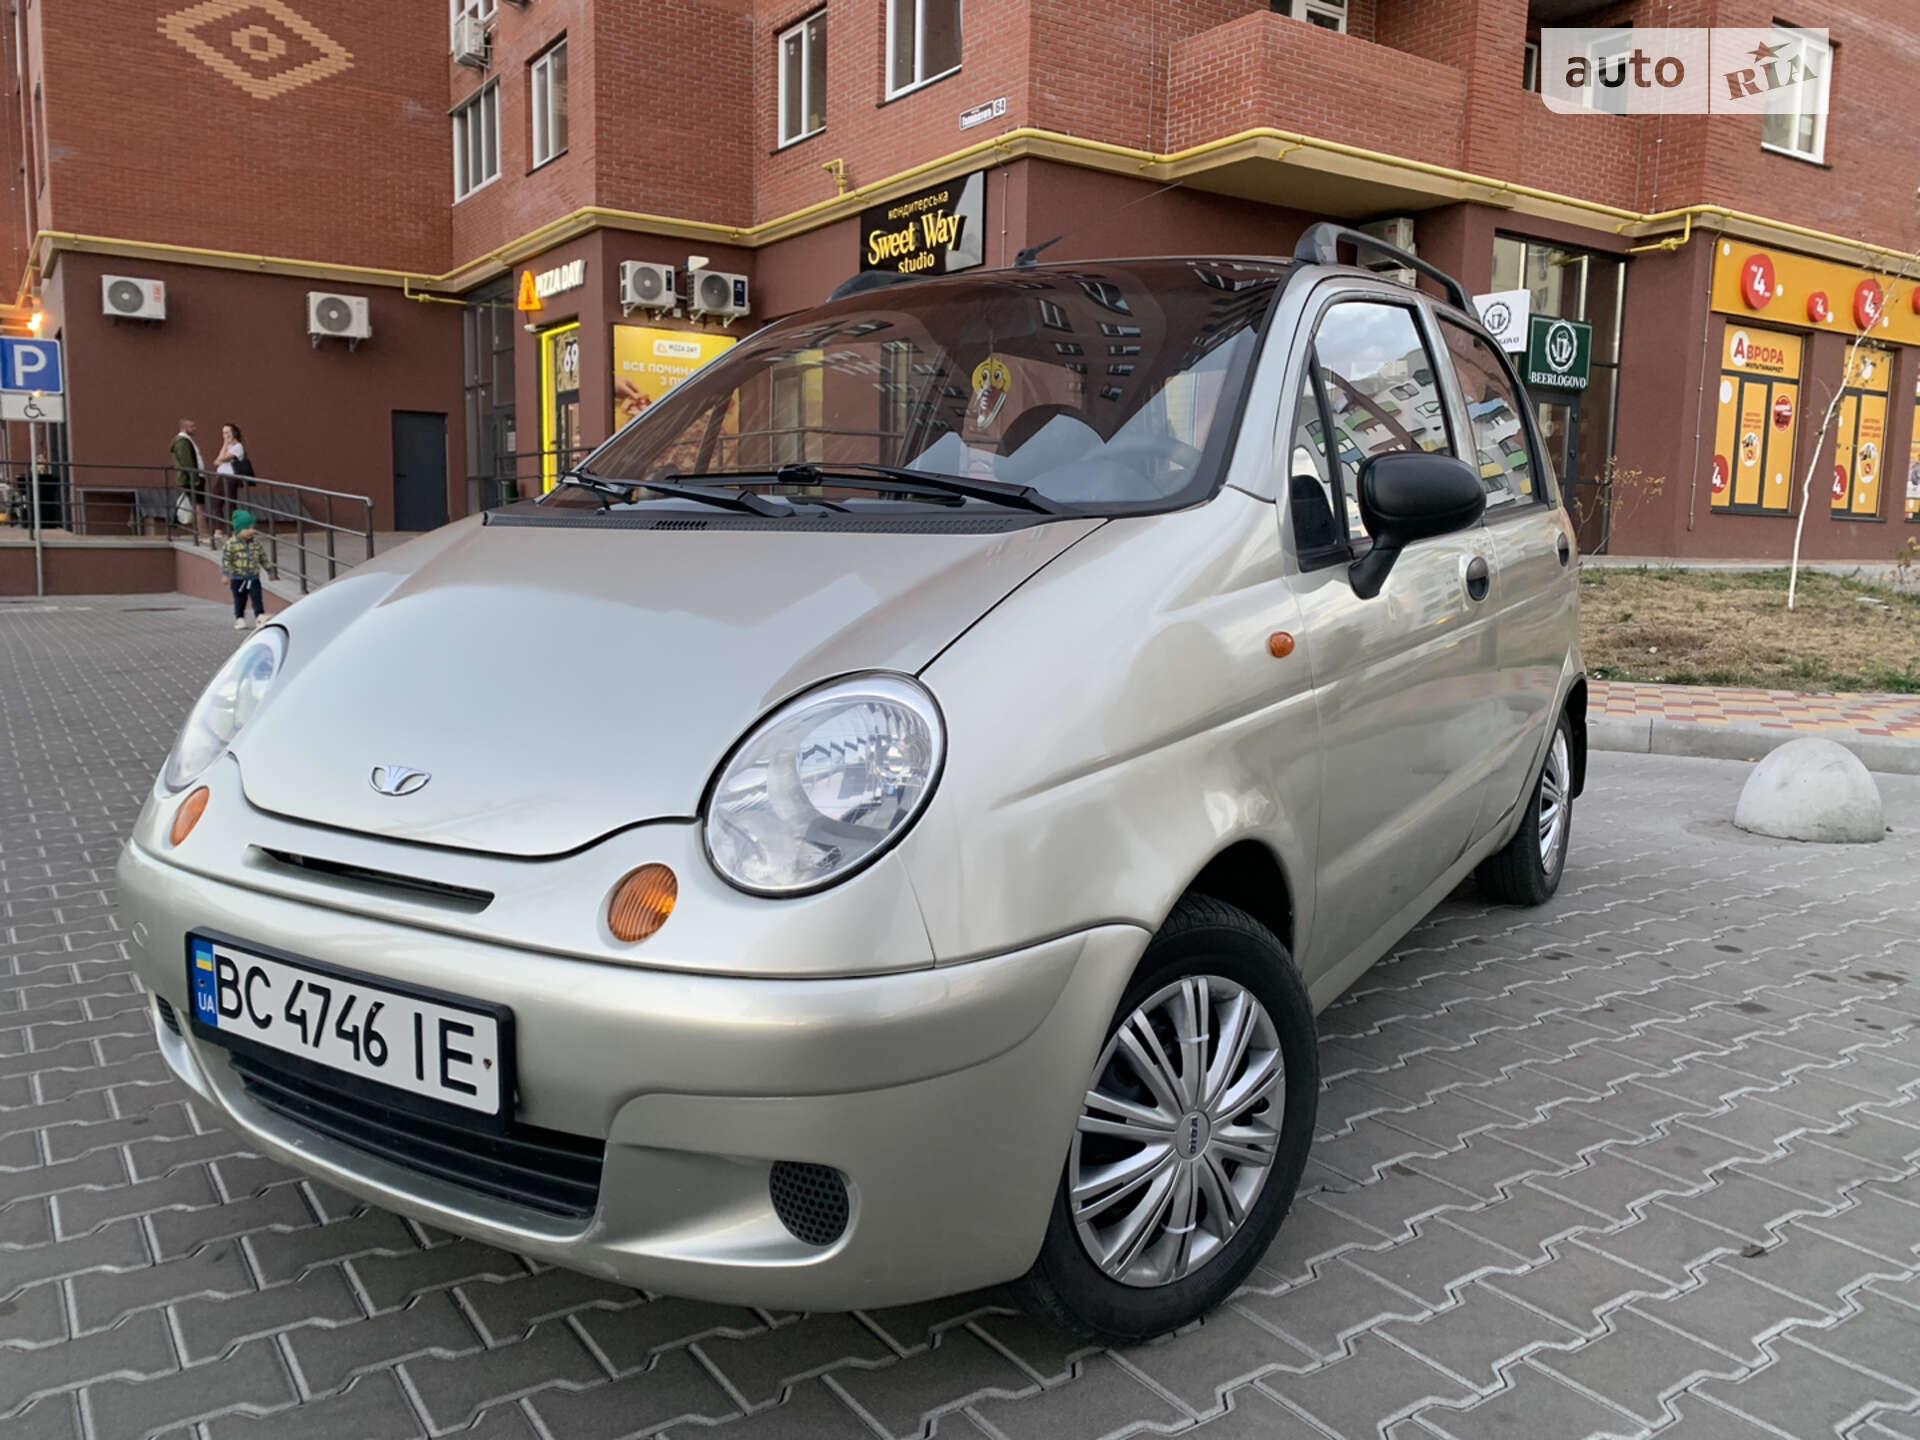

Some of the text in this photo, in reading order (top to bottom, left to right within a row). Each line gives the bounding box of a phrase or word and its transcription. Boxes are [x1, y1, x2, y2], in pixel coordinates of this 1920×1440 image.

[887, 191, 949, 220] кондитерська
[867, 209, 961, 265] Sweet Way
[898, 251, 935, 273] studio
[535, 259, 585, 298] PIZZA DAY
[13, 344, 47, 387] P
[622, 360, 646, 373] ВСЕ
[1531, 372, 1587, 389] BEERLOGOVO
[198, 992, 216, 1015] UA
[214, 953, 478, 1097] BC 4746 IE
